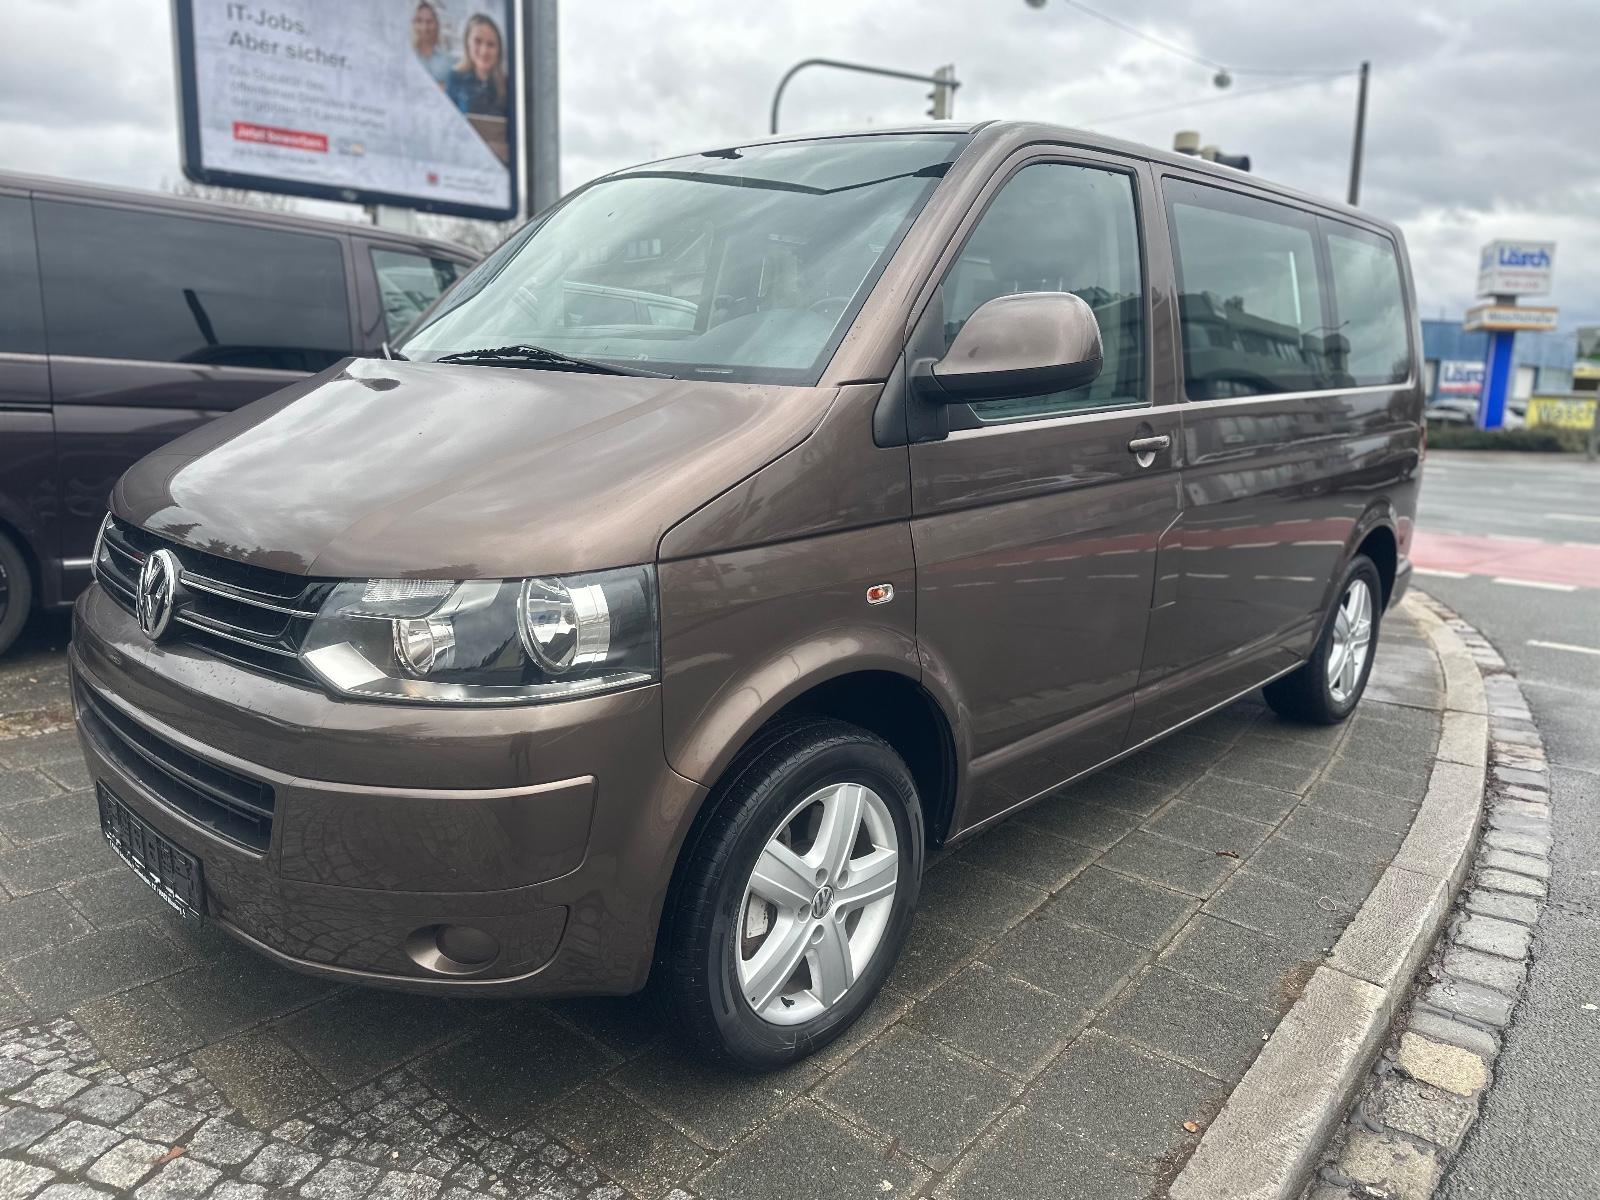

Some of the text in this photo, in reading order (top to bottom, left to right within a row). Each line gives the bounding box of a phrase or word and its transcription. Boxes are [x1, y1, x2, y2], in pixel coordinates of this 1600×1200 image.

[226, 2, 311, 37] IT-Jobs.
[228, 30, 352, 70] Aber sicher.
